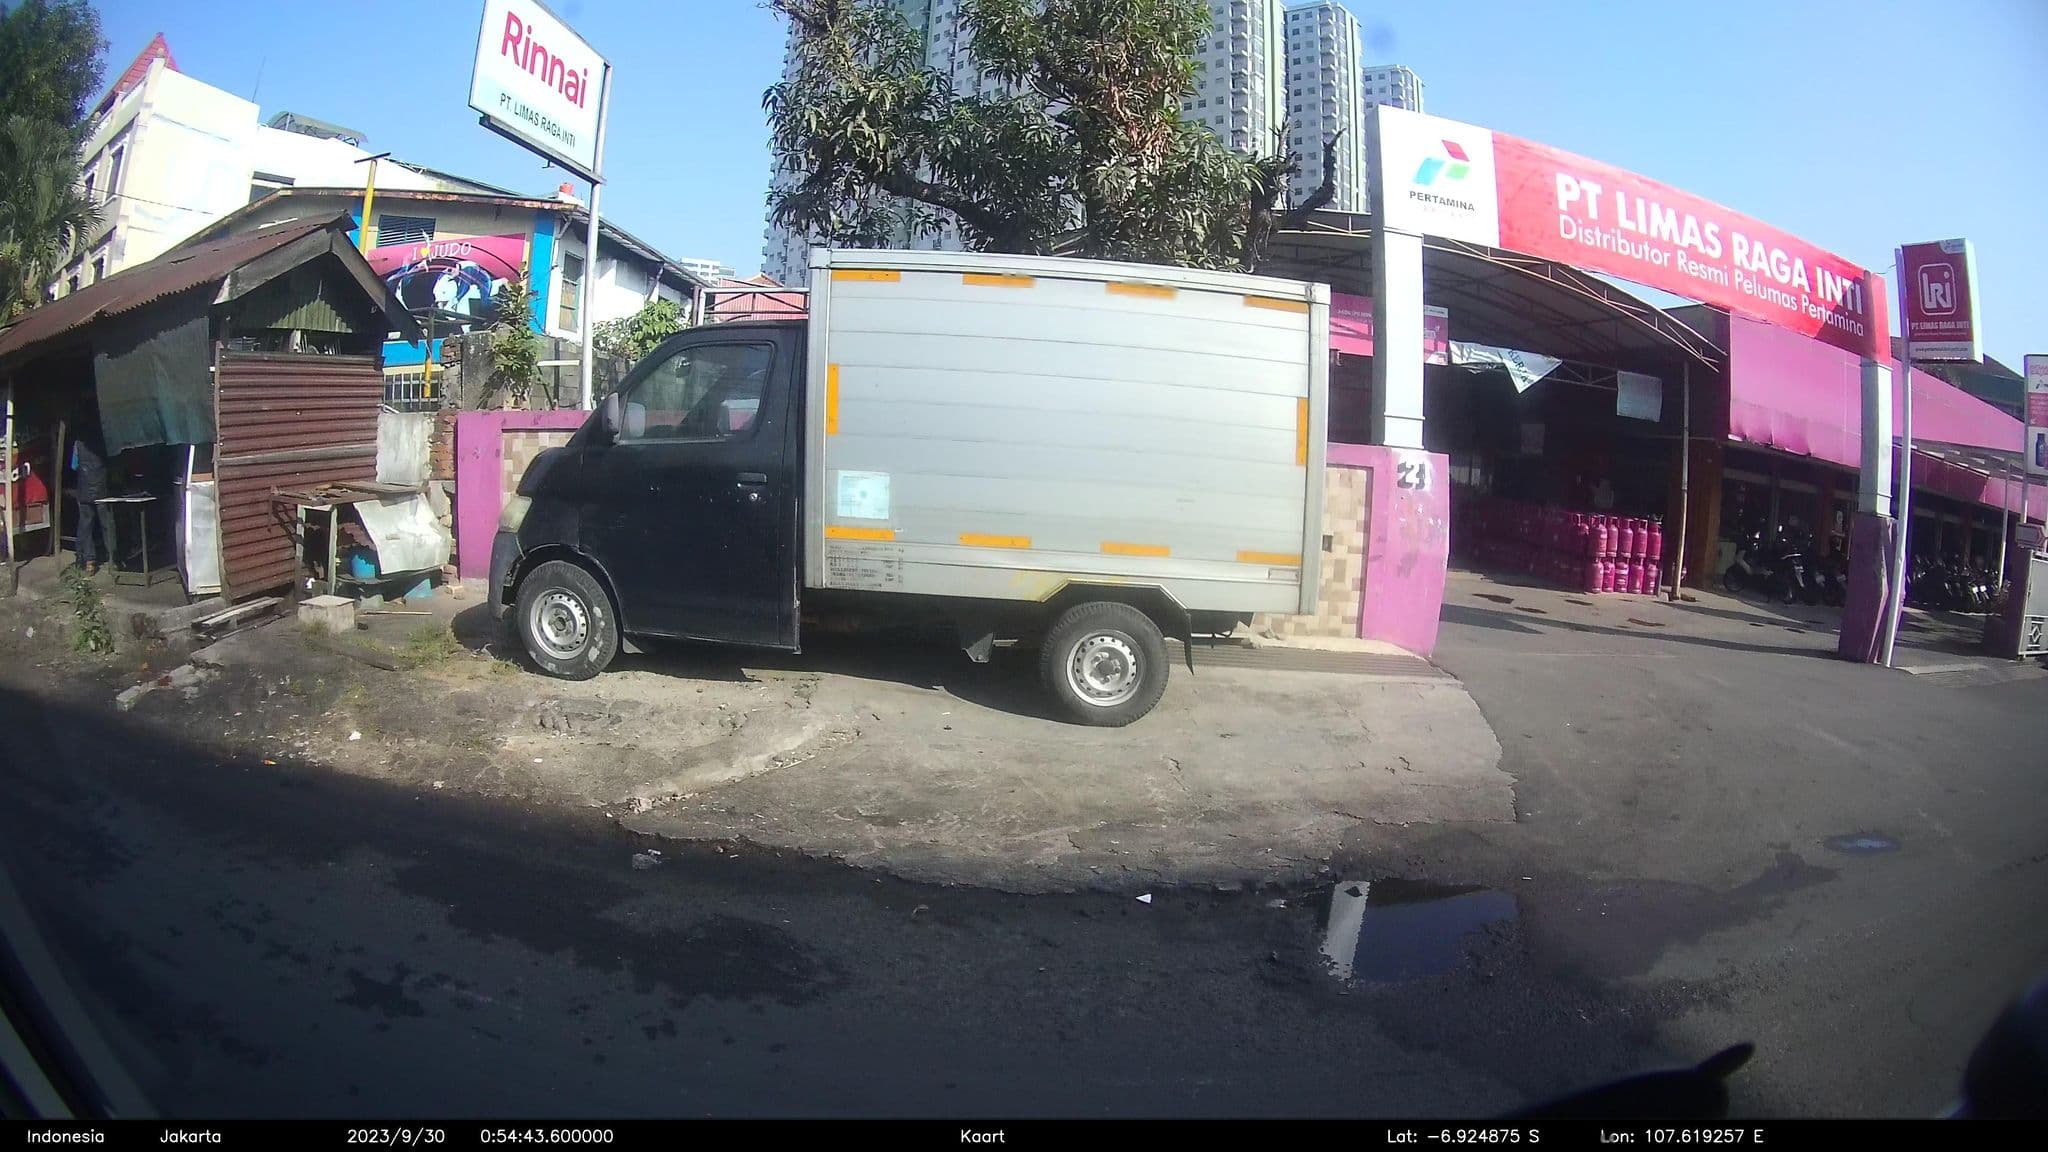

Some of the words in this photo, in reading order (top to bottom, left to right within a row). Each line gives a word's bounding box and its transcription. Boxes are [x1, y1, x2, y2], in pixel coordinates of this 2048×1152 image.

[501, 11, 588, 109] Rinnai
[514, 101, 539, 127] LIMAS
[541, 116, 561, 140] RAGA
[562, 129, 576, 148] INTI
[1409, 190, 1475, 212] PERTAMINA
[431, 242, 472, 260] JUDO
[1555, 172, 1603, 220] PT
[1615, 190, 1723, 259] LIMAS
[1731, 231, 1811, 293] RAGA
[1815, 265, 1863, 315] INTI
[1559, 213, 1671, 267] Distributor
[1677, 250, 1729, 287] Resmi
[1734, 270, 1798, 311] Pelumas
[1802, 296, 1864, 337] Pertamina
